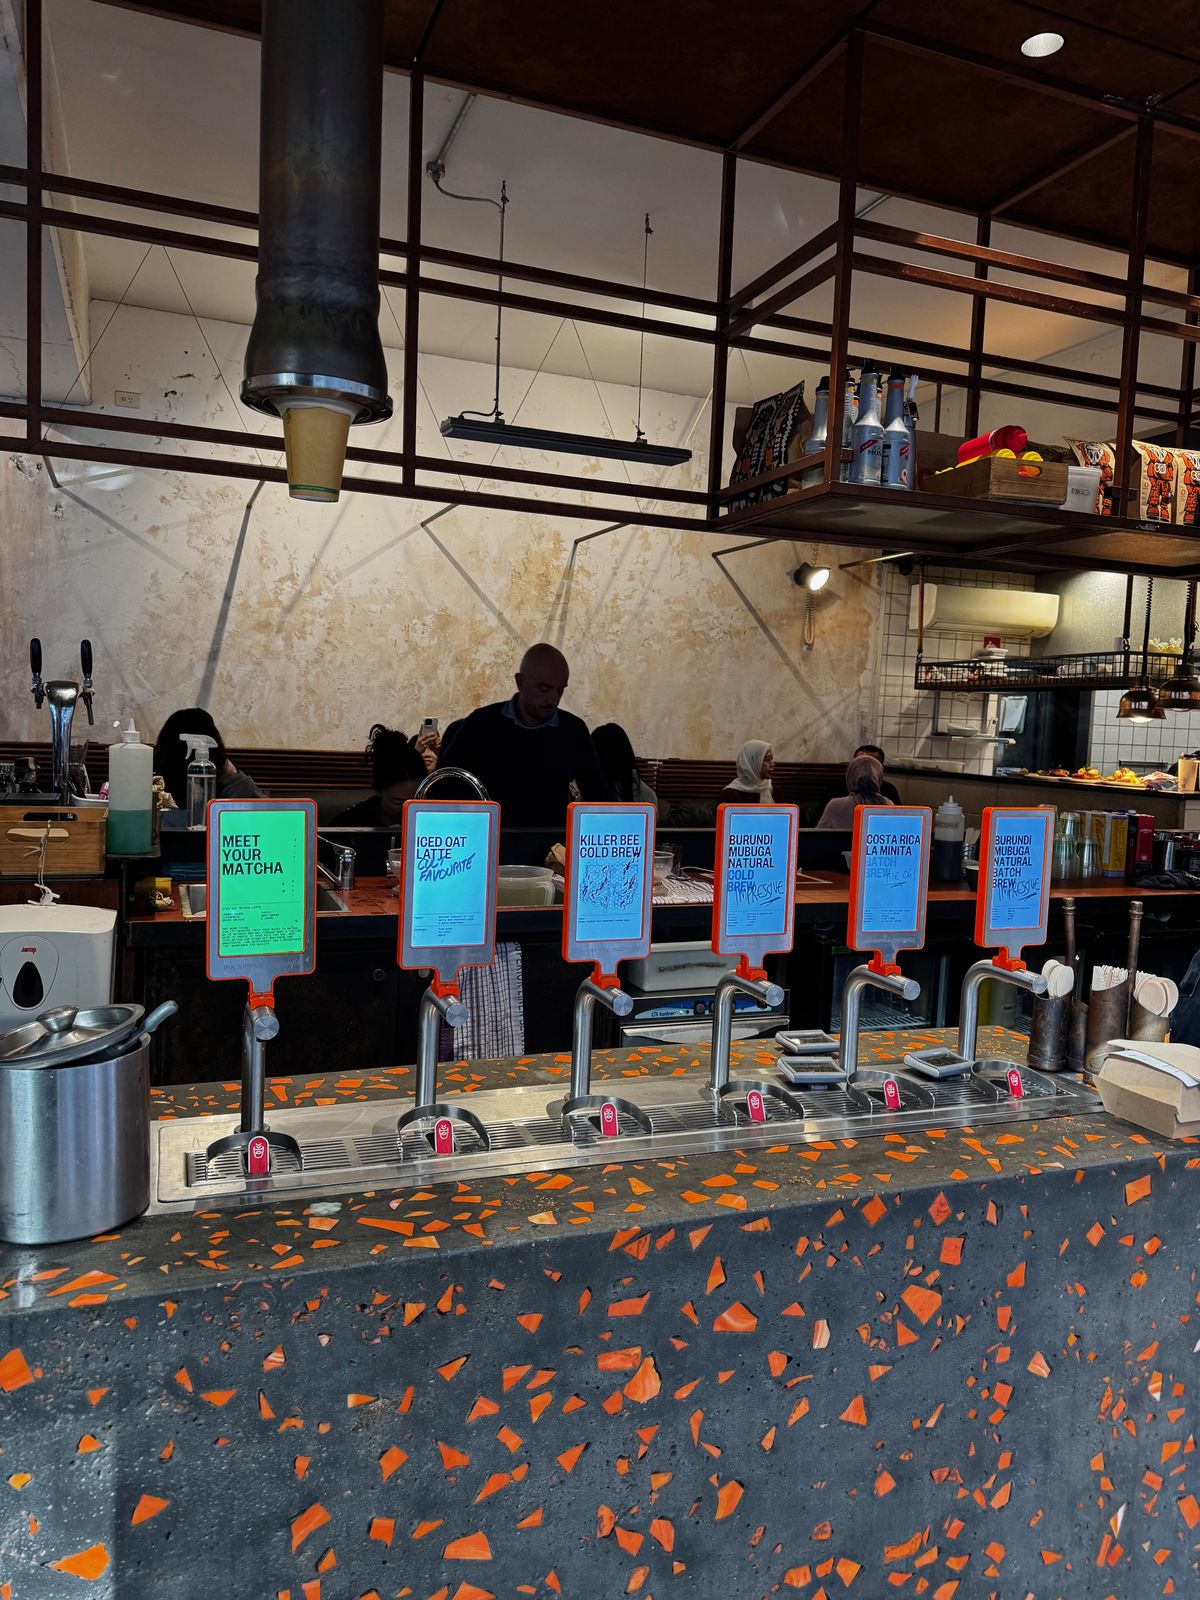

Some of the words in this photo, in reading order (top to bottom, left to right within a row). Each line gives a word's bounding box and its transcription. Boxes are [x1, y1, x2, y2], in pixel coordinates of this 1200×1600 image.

[222, 835, 261, 848] MEET
[417, 836, 443, 848] ICED
[445, 836, 468, 847] OAT
[580, 834, 617, 846] KILLER
[620, 834, 640, 846] BEE
[729, 834, 773, 846] BURUNDI
[867, 834, 898, 845] COSTA
[900, 834, 921, 845] RICA
[995, 835, 1032, 845] BURUNDI
[222, 848, 261, 861] YOUR
[416, 848, 452, 860] LATTE
[580, 846, 609, 858] COLD
[611, 846, 642, 858] BREW
[729, 846, 771, 857] MUBUGA
[866, 845, 878, 856] LA
[880, 845, 912, 856] MINITA
[995, 846, 1030, 856] MUBUGA
[417, 857, 446, 871] CULT
[419, 853, 476, 882] FAVOURITE
[728, 858, 775, 869] NATURAL
[866, 856, 897, 868] BATCH
[994, 856, 1033, 867] NATURAL
[222, 862, 283, 875] MATCHA
[866, 867, 892, 879] BREW
[993, 867, 1022, 878] BATCH
[728, 869, 755, 881] COLD
[728, 881, 756, 893] BREW
[993, 878, 1016, 889] BREW
